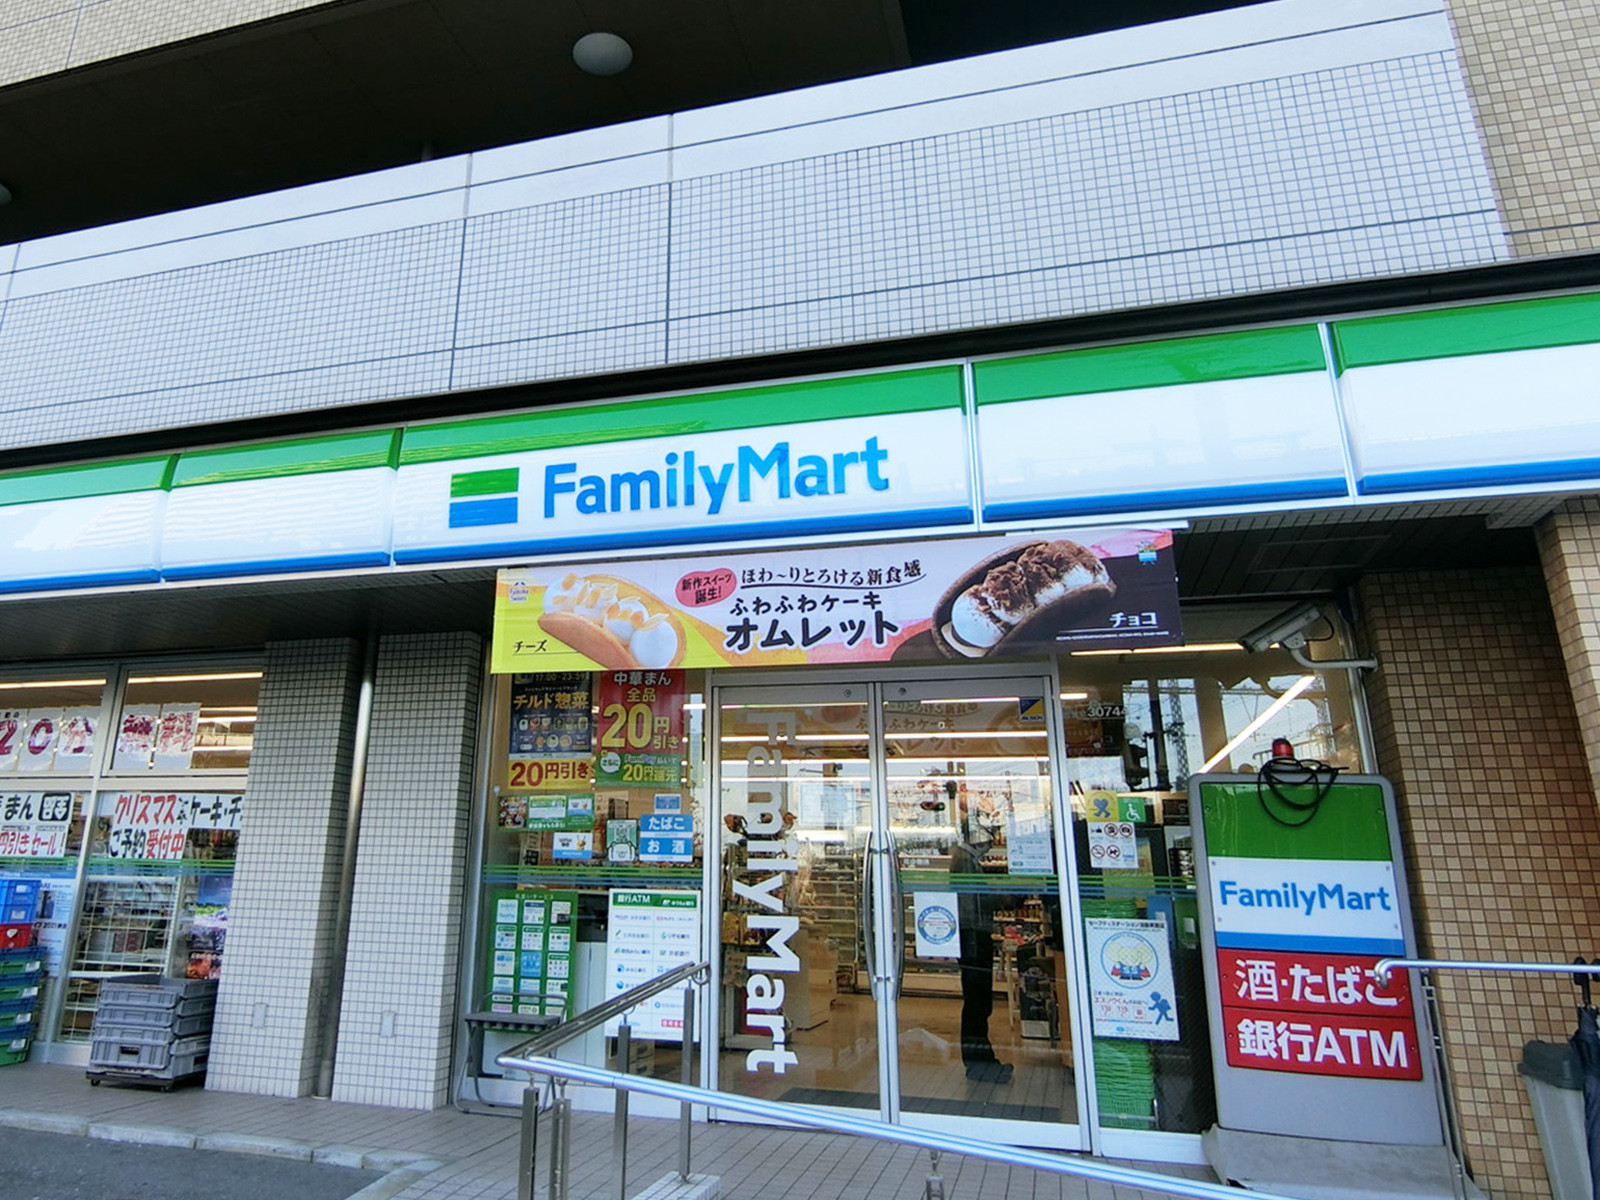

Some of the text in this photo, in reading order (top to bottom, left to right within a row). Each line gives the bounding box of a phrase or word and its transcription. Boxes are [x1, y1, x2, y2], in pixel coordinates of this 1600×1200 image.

[543, 437, 889, 518] FamilyMart
[681, 573, 732, 591] 新作スイーツ
[730, 591, 882, 616] ふわふわケーキ
[726, 609, 899, 651] オムレット
[1109, 611, 1157, 628] チョコ
[513, 639, 547, 652] チーズ
[614, 671, 672, 686] 中華まん
[627, 687, 656, 702] 全品
[510, 761, 589, 787] 20円引き
[115, 794, 177, 825] クリスマス
[648, 816, 685, 830] たばこ
[110, 828, 185, 860] ご予約受付中
[733, 711, 799, 1074] FamilyMart
[1219, 880, 1392, 916] FamilyMart
[1235, 958, 1399, 1007] 酒・たばこ
[1237, 1017, 1409, 1069] 銀行ATM
